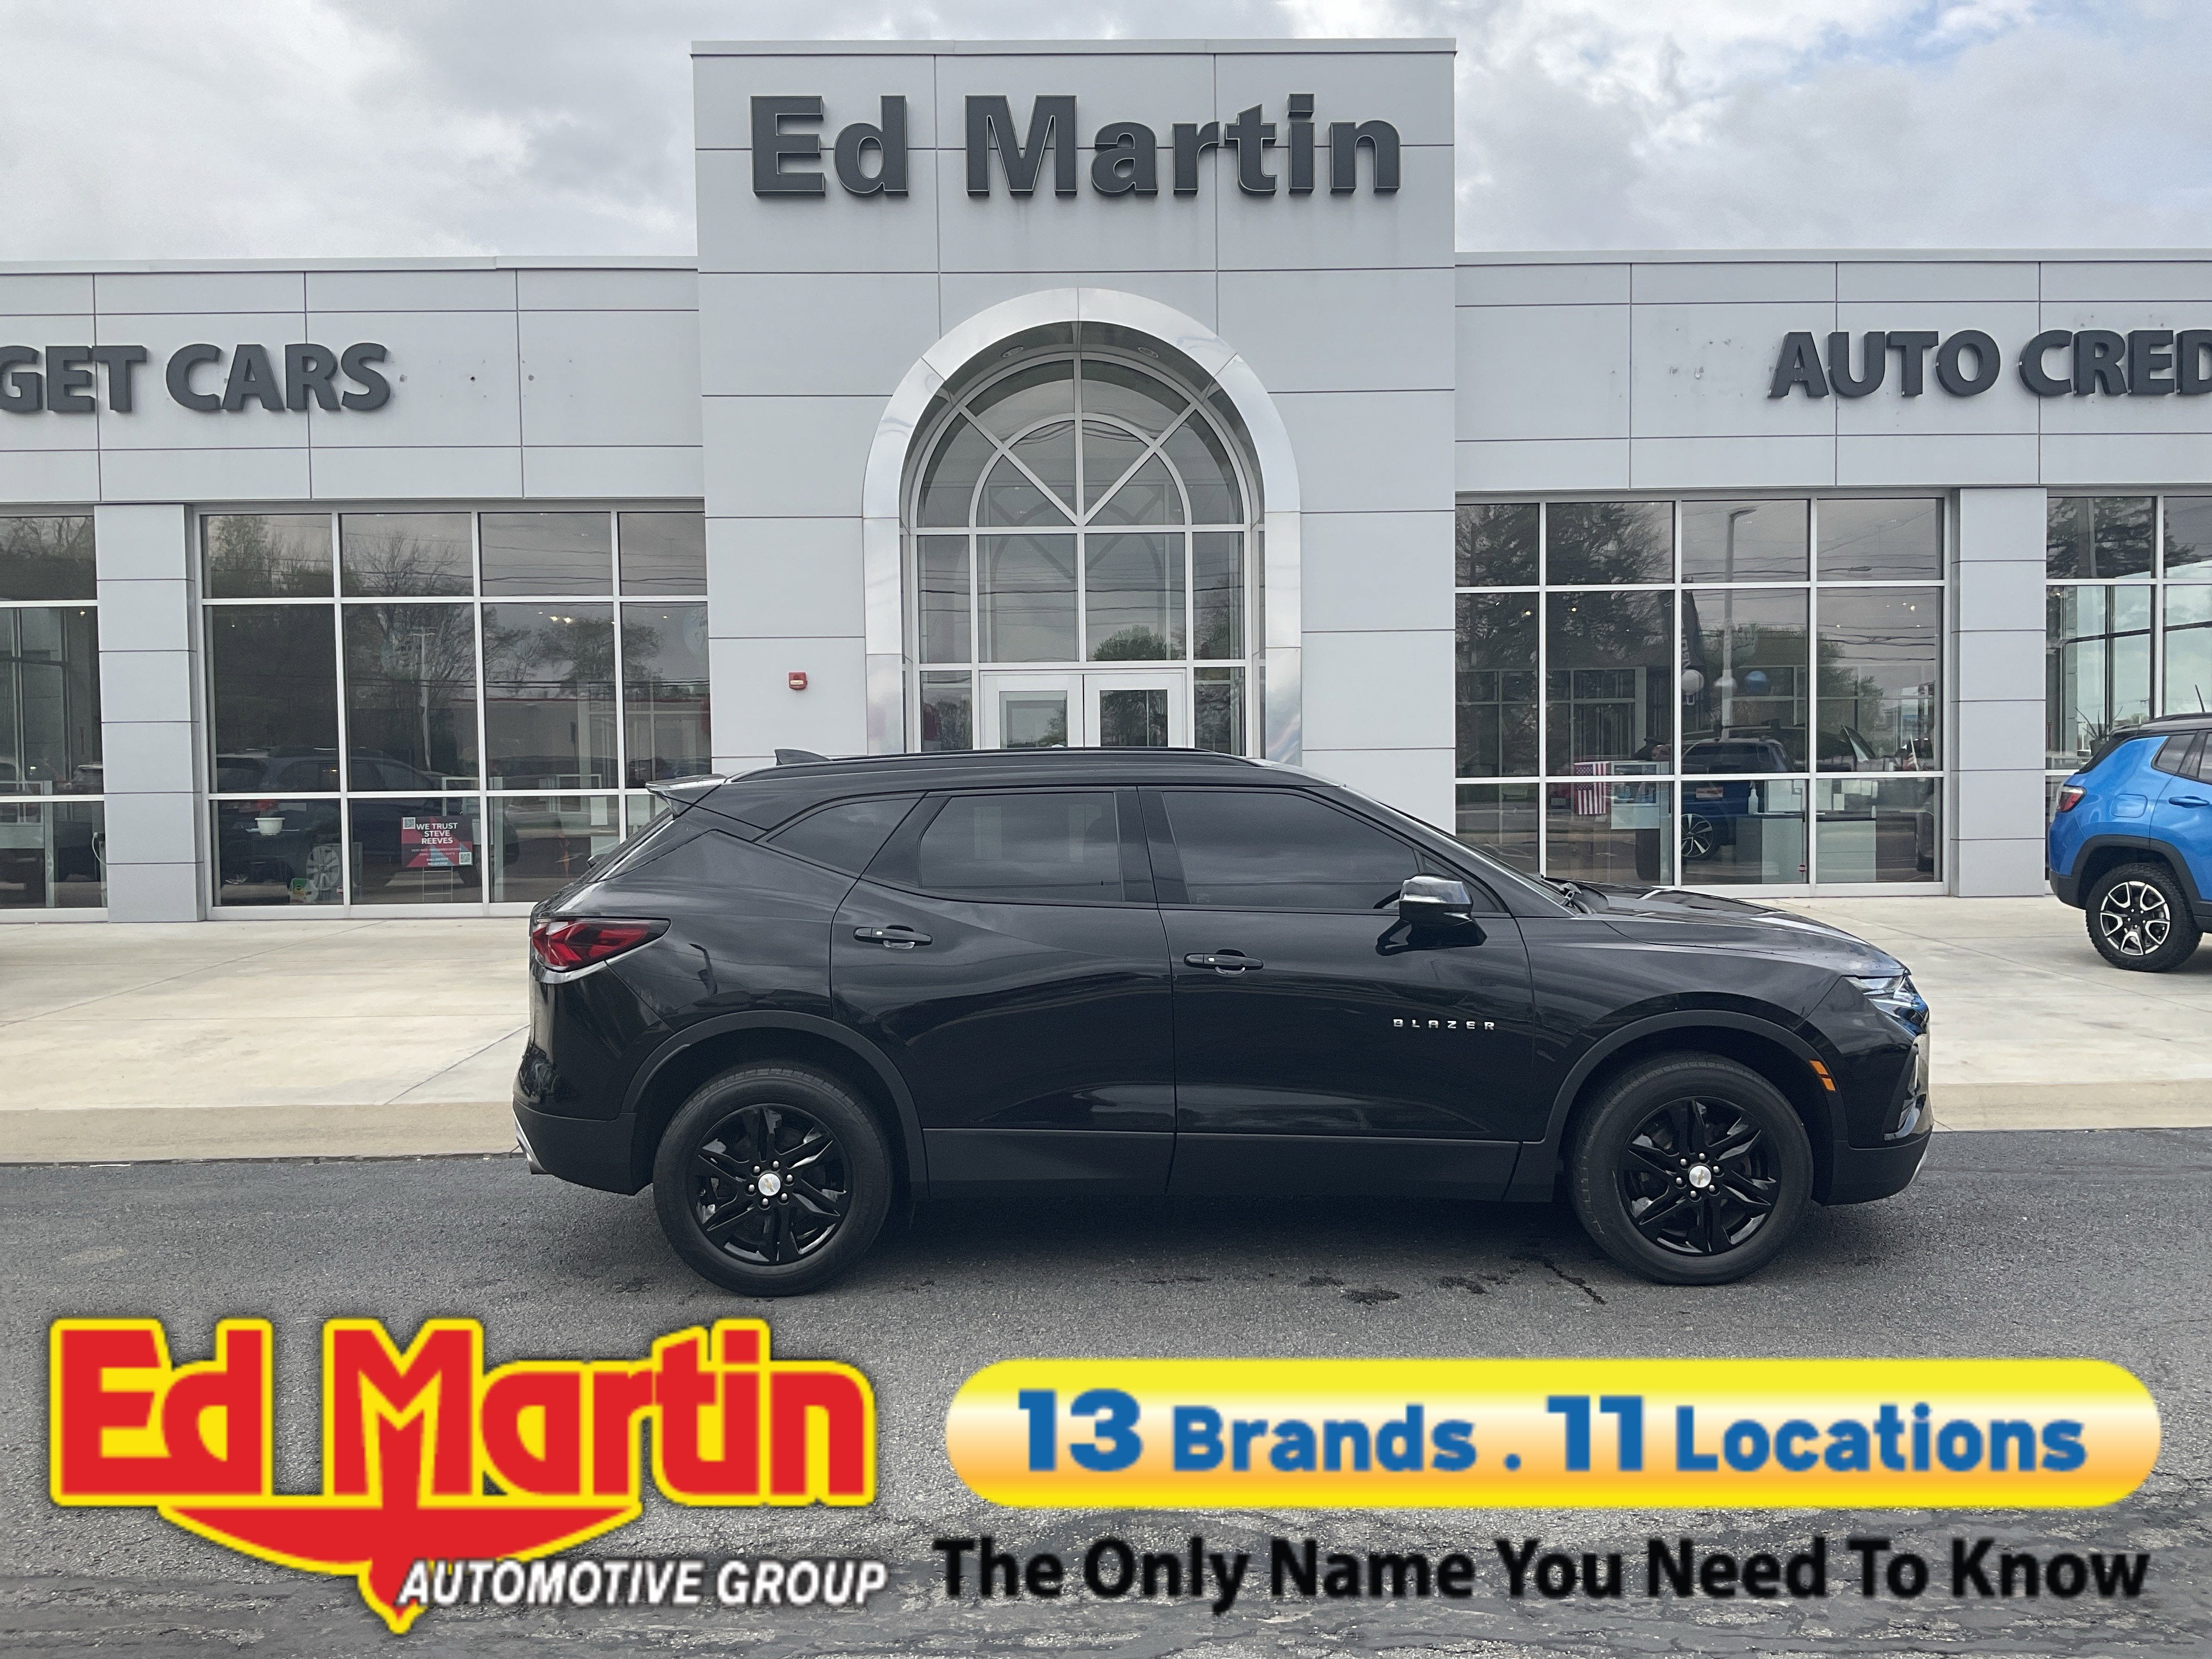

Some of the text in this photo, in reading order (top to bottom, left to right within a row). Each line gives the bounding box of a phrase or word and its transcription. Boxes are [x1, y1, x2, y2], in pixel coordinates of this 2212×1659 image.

[750, 93, 1401, 197] Ed Martin
[166, 342, 391, 411] CARS
[1767, 329, 2001, 399] AUTO
[1393, 1019, 1495, 1030] BLAZER
